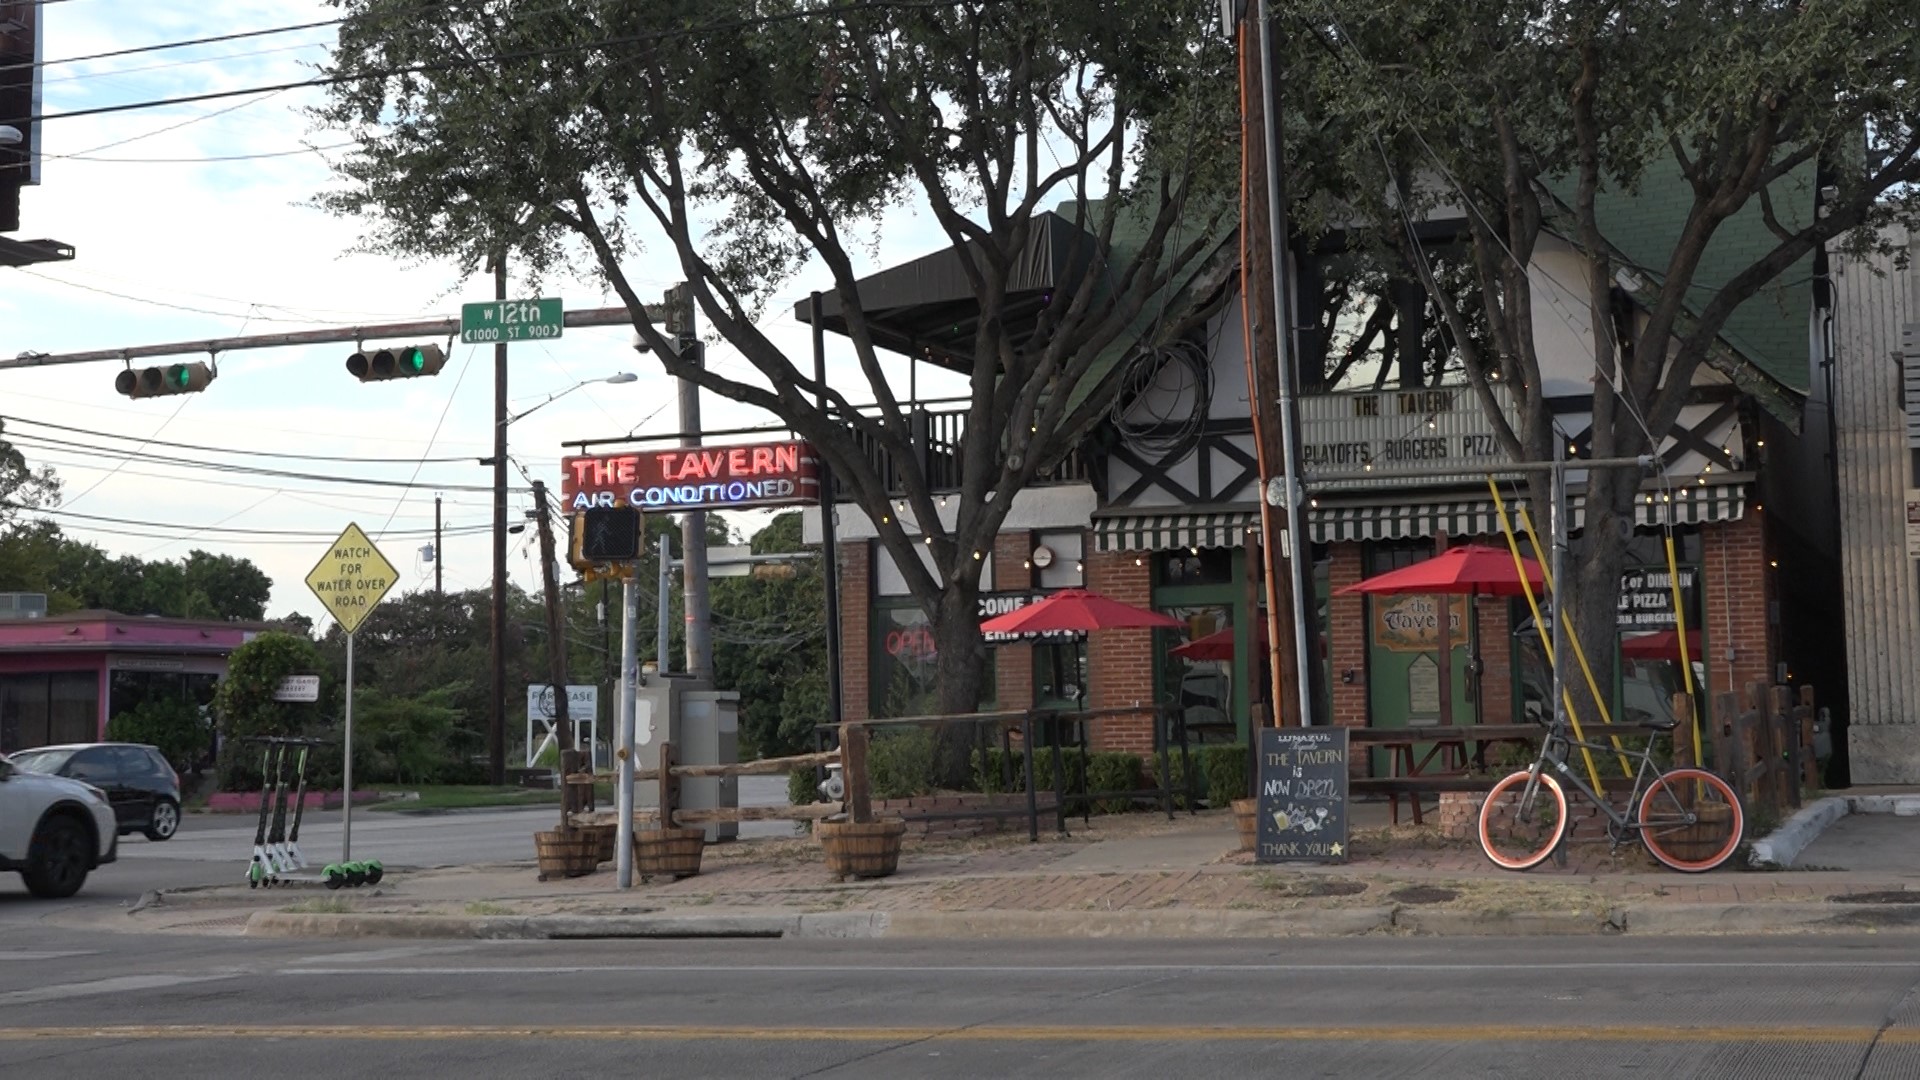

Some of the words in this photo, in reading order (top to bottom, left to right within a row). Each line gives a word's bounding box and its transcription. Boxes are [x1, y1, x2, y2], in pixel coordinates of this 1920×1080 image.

[484, 310, 493, 320] W
[474, 328, 499, 340] 1000
[508, 326, 520, 338] ST
[529, 325, 550, 338] 900
[1354, 397, 1379, 416] THE
[1398, 392, 1453, 413] TAVERN
[1303, 442, 1370, 465] PLAYOFFS
[1386, 438, 1447, 461] BURGERS
[572, 456, 639, 485] THE
[657, 446, 798, 480] TAVERN
[573, 492, 614, 509] AIR
[631, 478, 794, 507] CONDITIONED
[334, 547, 370, 559] WATCH
[340, 563, 362, 575] FOR
[317, 580, 351, 591] WATER
[356, 578, 385, 590] OVER
[335, 596, 366, 606] ROAD
[1410, 600, 1433, 612] the
[1633, 593, 1667, 608] PIZZA
[1384, 609, 1460, 630] Taven
[1267, 753, 1288, 766] THE
[1297, 748, 1342, 765] TAVERN
[1264, 779, 1291, 796] NOW
[1263, 843, 1300, 856] THANK
